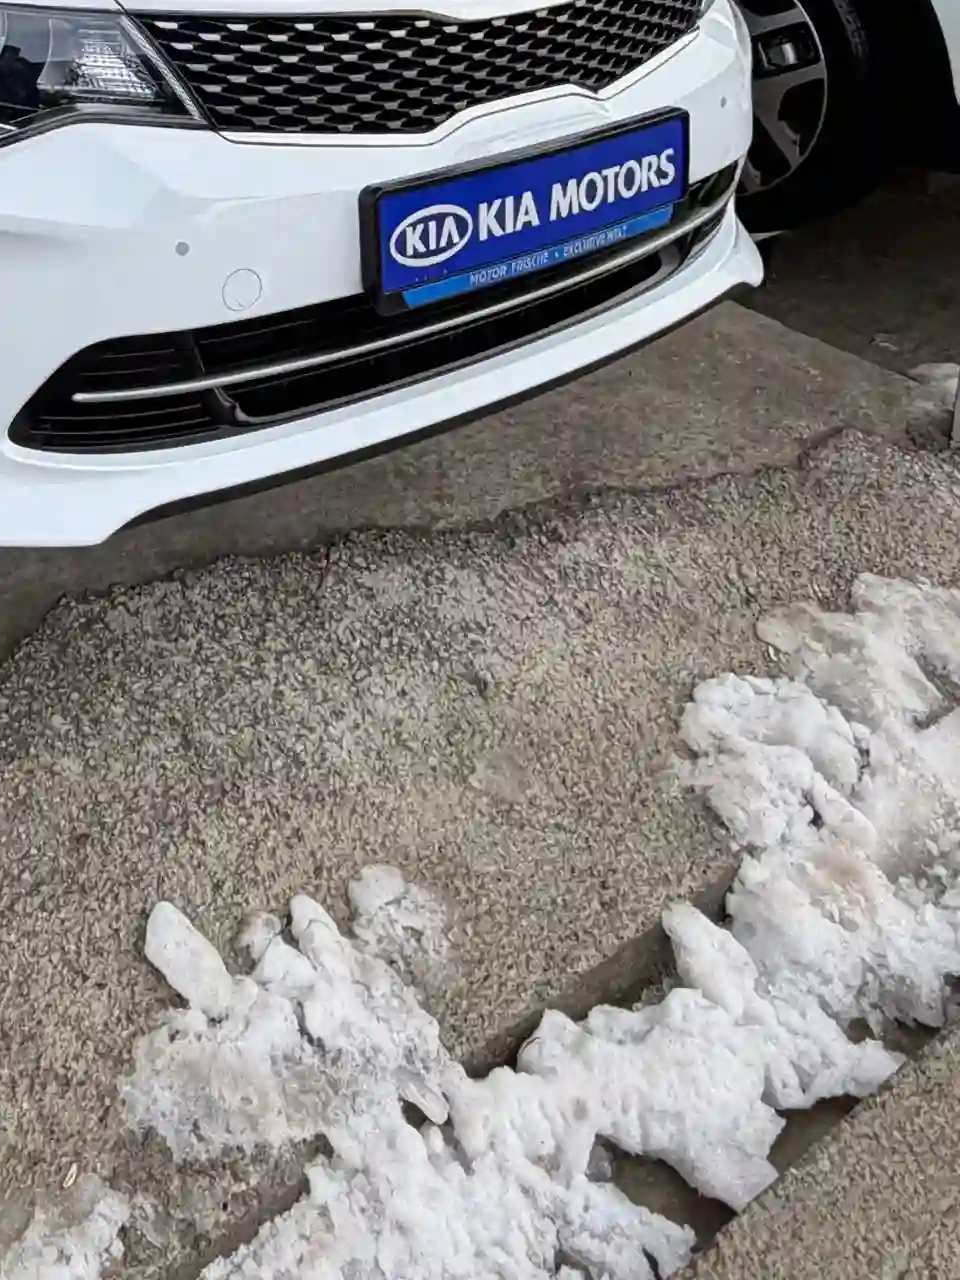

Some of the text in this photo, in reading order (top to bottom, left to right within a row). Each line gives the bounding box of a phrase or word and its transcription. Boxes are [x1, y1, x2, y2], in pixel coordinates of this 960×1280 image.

[403, 147, 676, 256] KIA KIA MOTORS
